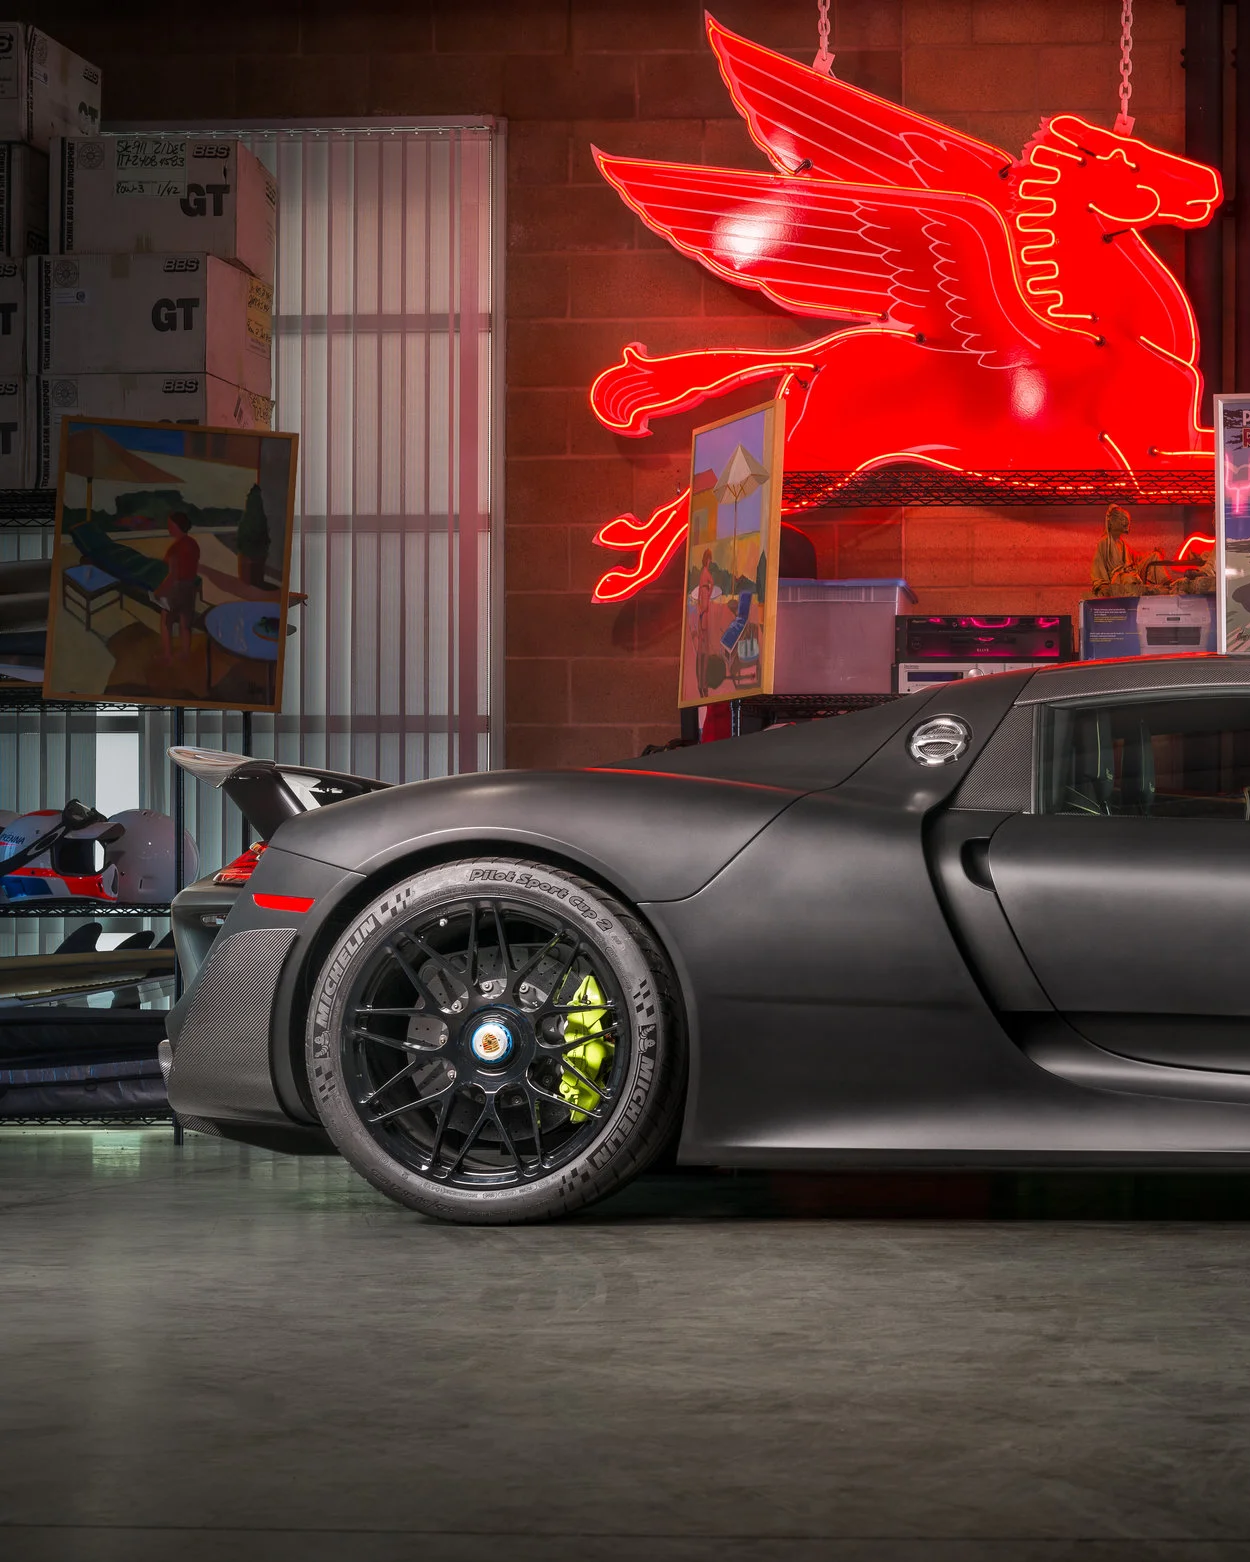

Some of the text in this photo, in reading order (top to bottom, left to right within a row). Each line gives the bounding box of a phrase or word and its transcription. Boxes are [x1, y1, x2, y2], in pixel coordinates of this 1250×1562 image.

[66, 142, 75, 187] MOTORSPORT
[192, 144, 230, 158] BBS
[180, 183, 230, 217] GT
[0, 262, 17, 278] BS
[163, 257, 200, 273] BBS
[0, 302, 18, 335] T
[151, 298, 199, 333] GT
[0, 381, 18, 395] BS
[162, 378, 199, 394] BBS
[0, 422, 18, 455] T
[468, 869, 614, 933] Pilot Sport Cup 2
[315, 914, 380, 1027] MICHELIN
[588, 1056, 655, 1169] MICHELIN
